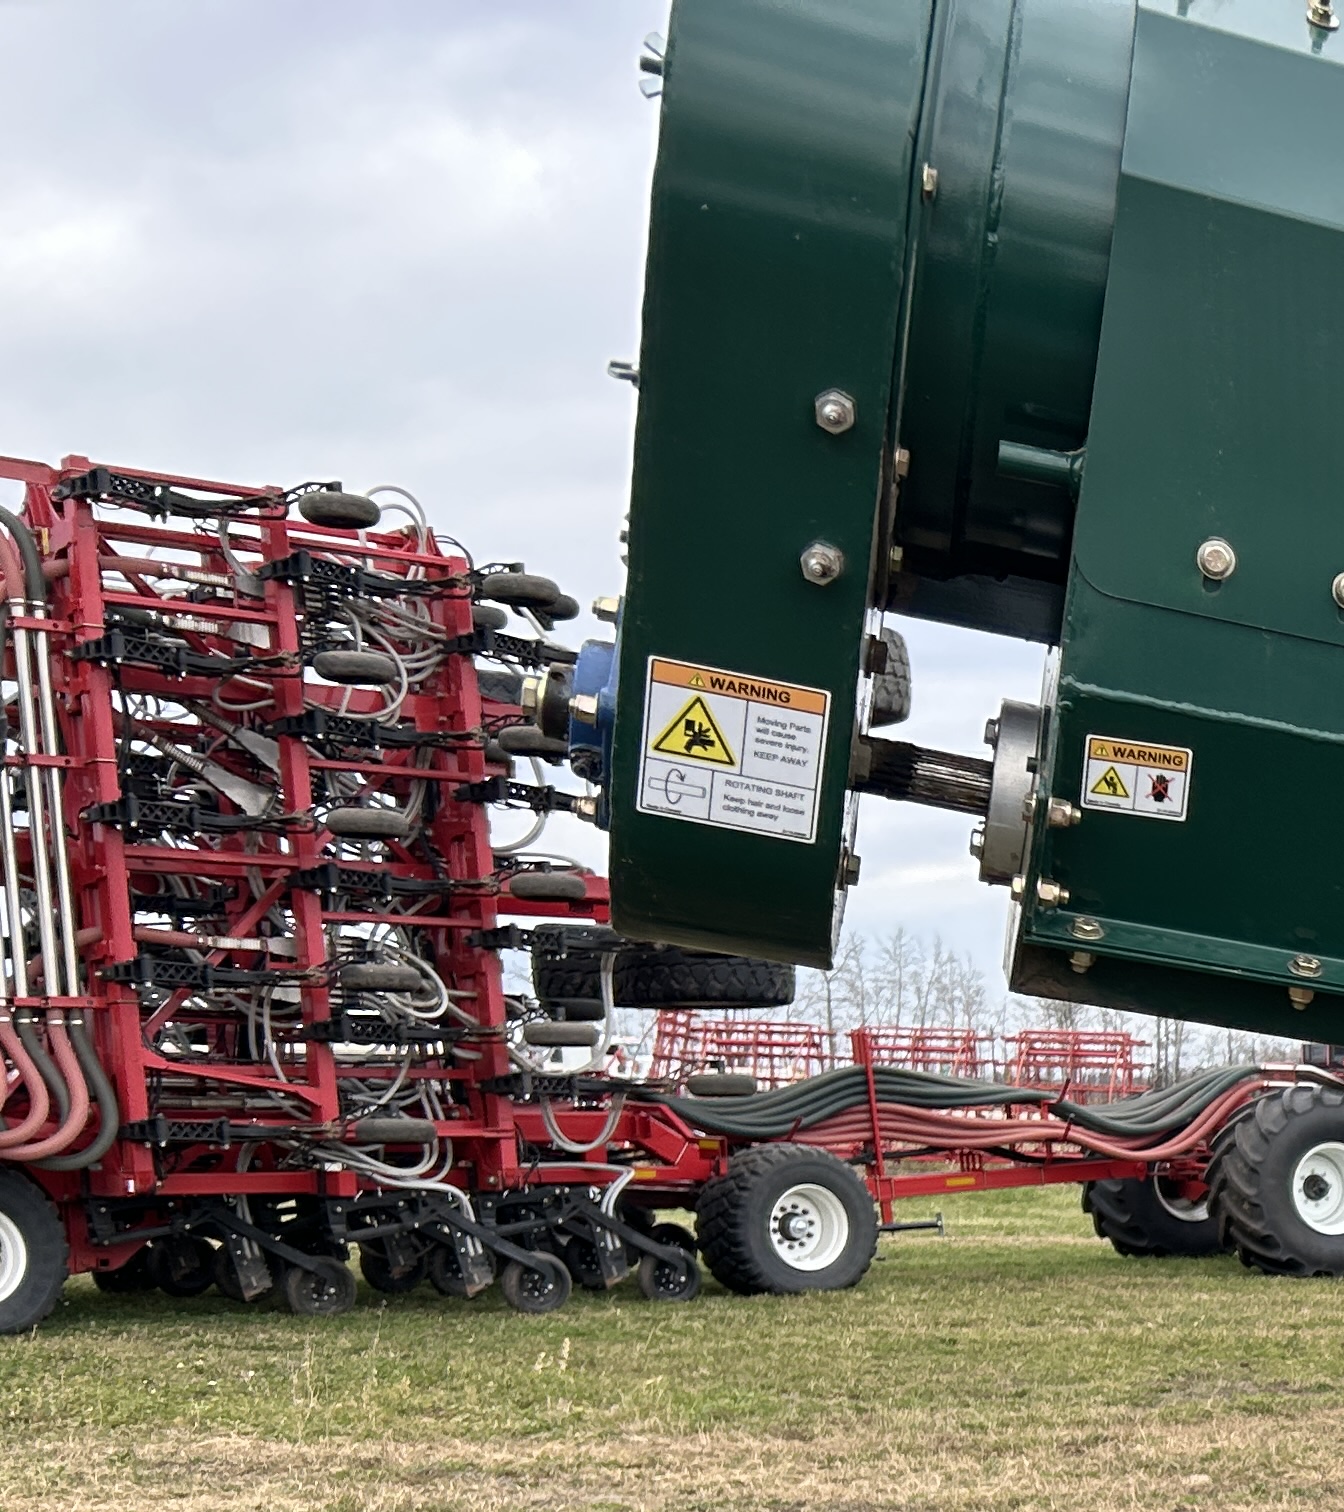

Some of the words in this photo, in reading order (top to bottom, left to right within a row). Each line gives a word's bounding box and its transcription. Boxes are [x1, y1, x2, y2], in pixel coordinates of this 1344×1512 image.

[709, 676, 791, 703] WARNING
[755, 726, 769, 734] will
[771, 730, 795, 740] cause
[757, 716, 787, 729] Moving
[789, 722, 811, 733] Parts
[753, 750, 778, 761] KEEP
[780, 755, 808, 767] AWAY
[1113, 746, 1183, 766] WARNING
[724, 779, 772, 794] ROTATING
[774, 789, 804, 801] SHAFT
[722, 803, 754, 816] clothing
[756, 811, 778, 821] away
[723, 793, 745, 804] Keep
[747, 798, 763, 807] hair
[765, 801, 780, 810] and
[782, 805, 804, 815] loose
